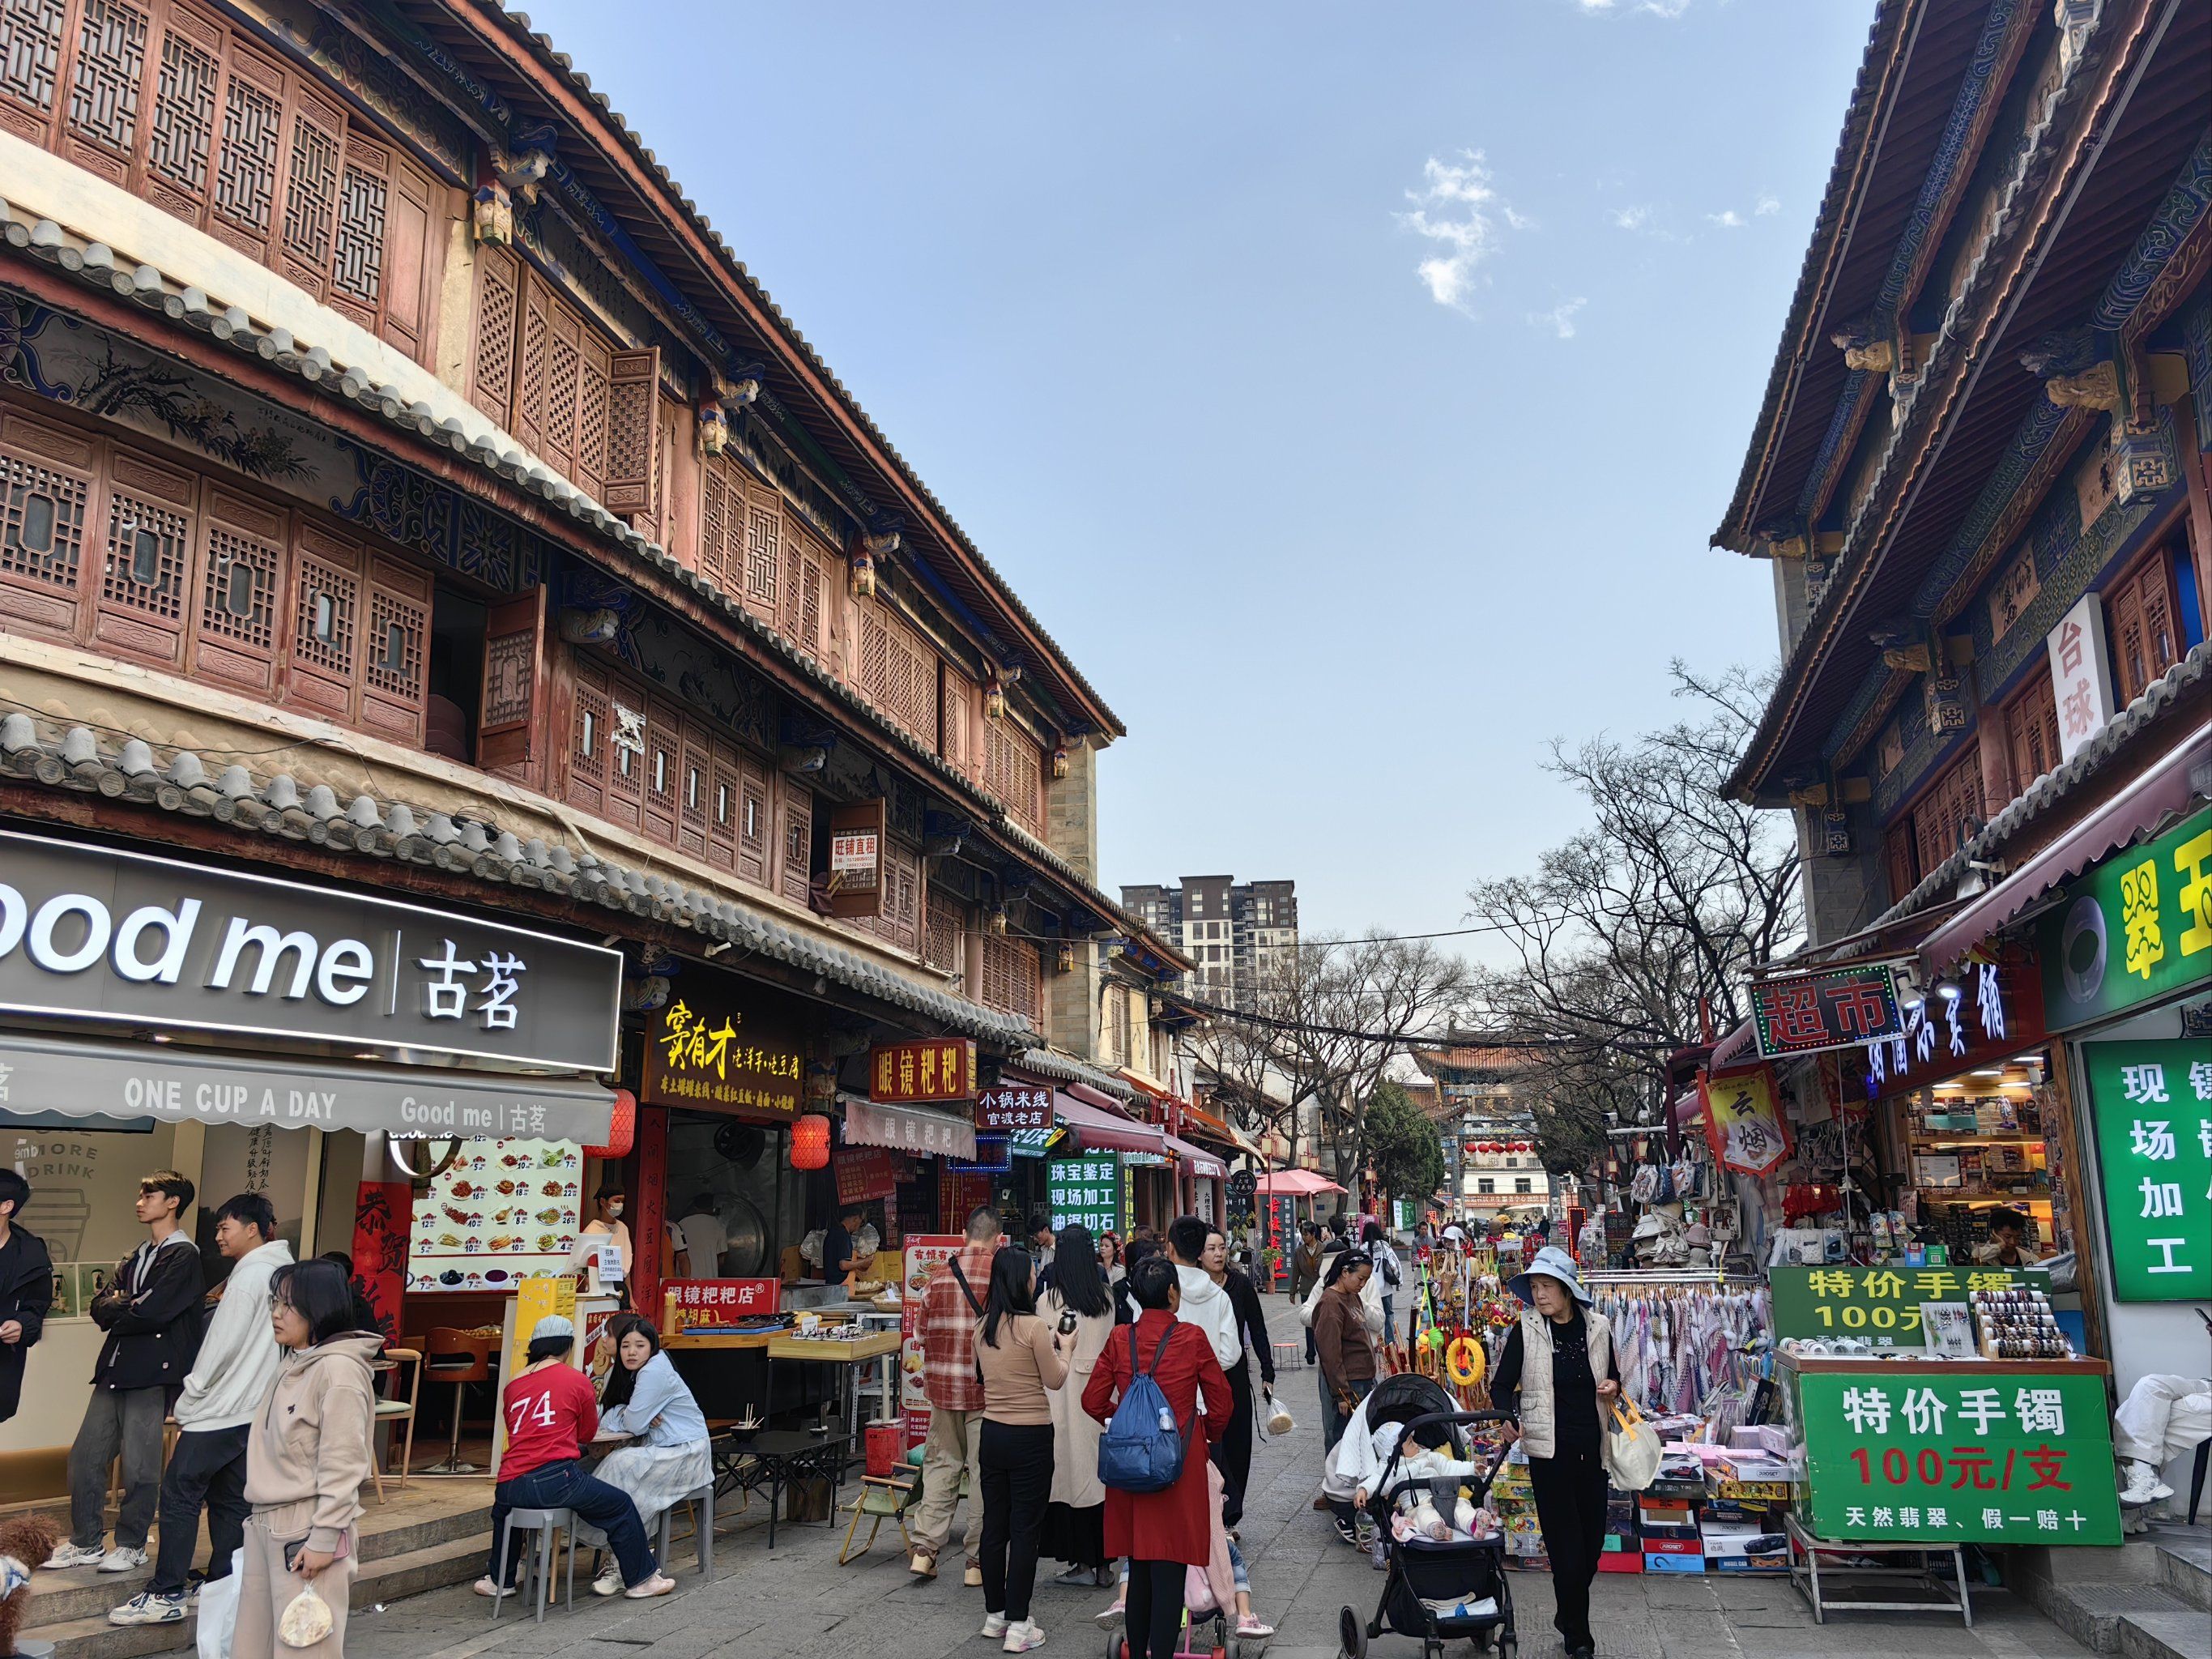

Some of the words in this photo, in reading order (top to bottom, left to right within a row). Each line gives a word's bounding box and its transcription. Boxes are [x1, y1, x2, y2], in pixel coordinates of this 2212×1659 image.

[2057, 621, 2096, 740] 台球
[835, 838, 876, 855] 旺铺直租
[210, 915, 373, 1005] me
[421, 938, 527, 1030] 古茗
[1762, 975, 1887, 1046] 超市
[878, 1047, 957, 1095] 眼镜粑粑
[124, 1077, 181, 1110] ONE
[196, 1081, 248, 1113] CUP
[259, 1085, 276, 1115] A
[288, 1089, 337, 1120] DAY
[401, 1096, 454, 1128] Good
[463, 1102, 492, 1128] me
[510, 1103, 547, 1133] 古茗
[979, 1090, 1050, 1109] 小锅米线
[884, 1117, 952, 1148] 眼镜粑粑
[987, 1111, 1043, 1125] 官渡老店
[1729, 1091, 1767, 1152] 云烟
[27, 1162, 96, 1179] DRINK
[1051, 1163, 1115, 1182] 珠宝鉴定
[2120, 1064, 2193, 1273] 现场加工
[1051, 1188, 1115, 1207] 现场加工
[1052, 1213, 1115, 1230] 油锯切石
[1374, 1257, 1382, 1273] 7
[1809, 1270, 2014, 1299] 特价手镯
[509, 1390, 556, 1435] 74
[1842, 1388, 2065, 1436] 特价手镯
[1850, 1444, 2073, 1494] 100元/支
[1845, 1507, 2087, 1532] 天然翡翠、假一赔十
